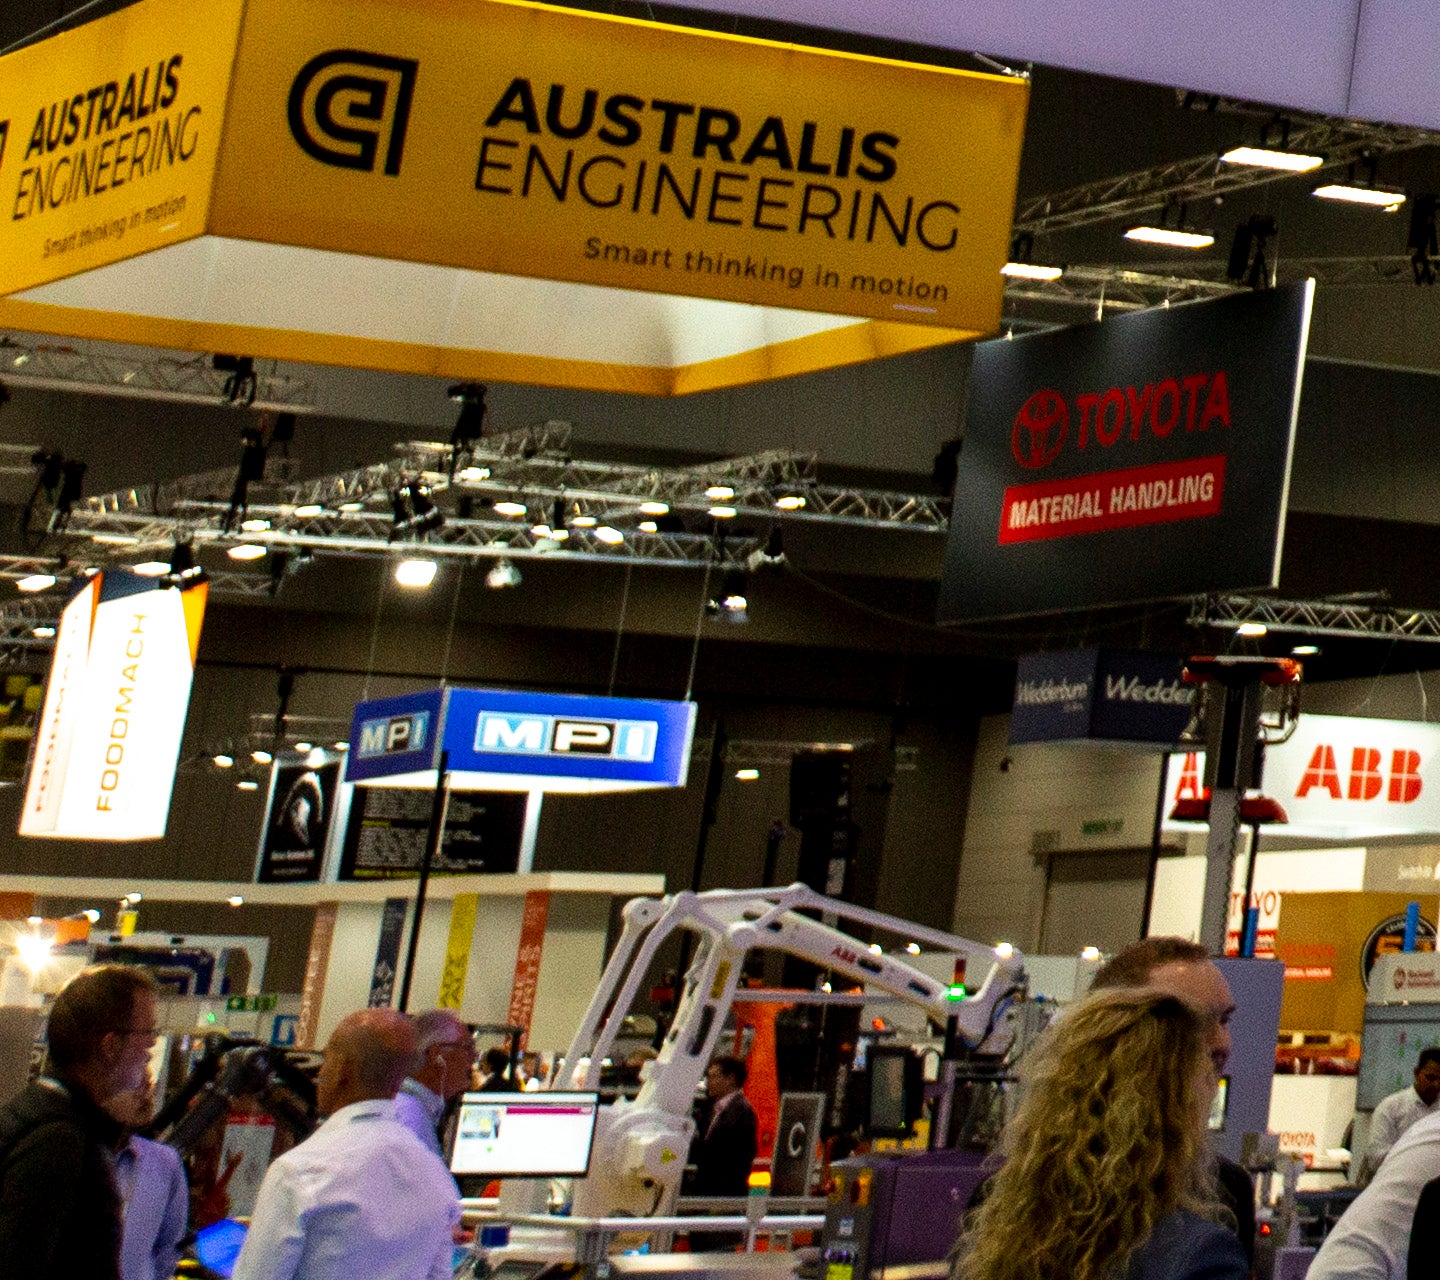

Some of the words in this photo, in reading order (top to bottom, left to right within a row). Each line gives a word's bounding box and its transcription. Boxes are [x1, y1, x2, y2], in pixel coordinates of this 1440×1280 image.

[25, 53, 183, 161] AUSTRALIS
[485, 77, 901, 183] AUSTRALIS
[12, 105, 202, 221] ENGINEERING
[474, 137, 962, 252] ENGINEERING
[583, 236, 673, 270] Smart
[684, 250, 804, 290] thinking
[816, 263, 840, 288] in
[850, 274, 950, 302] motion
[1076, 370, 1231, 450] TOYOTA
[1008, 490, 1103, 530] MATERIAL
[1109, 472, 1215, 514] HANDLING
[96, 613, 149, 812] FOODMACH
[360, 714, 428, 755] MPI
[482, 717, 647, 759] MPI
[1294, 744, 1423, 804] ABB
